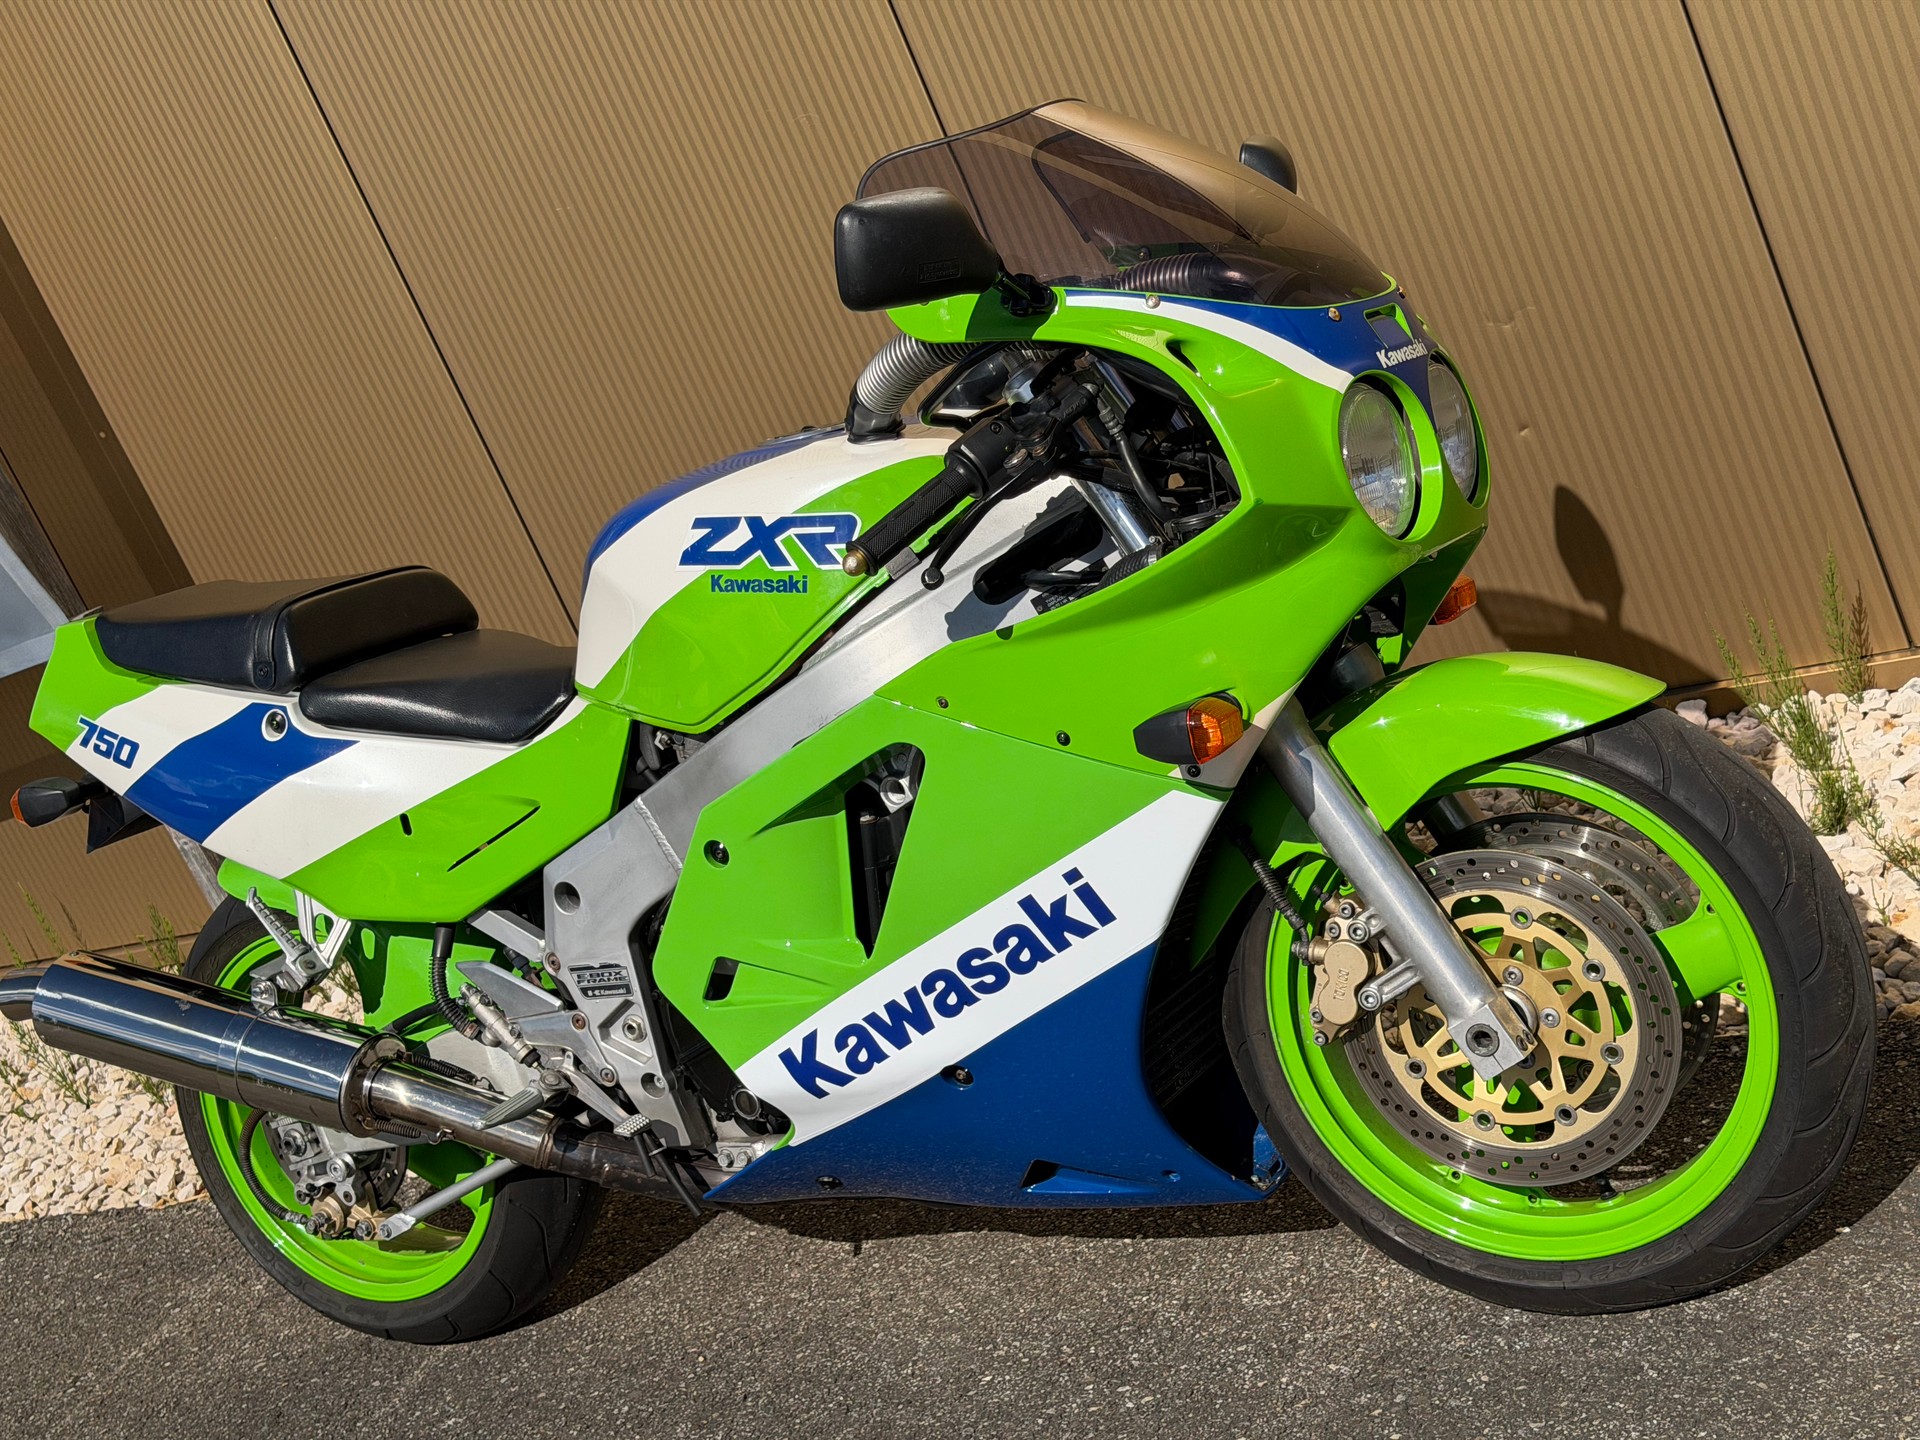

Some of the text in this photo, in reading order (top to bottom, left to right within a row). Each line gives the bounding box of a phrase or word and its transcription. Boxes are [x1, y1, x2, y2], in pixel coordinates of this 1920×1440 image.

[1376, 337, 1428, 369] Kawasaki
[678, 513, 858, 568] ZXR
[711, 574, 808, 594] Kawasaki
[79, 716, 140, 769] 750
[576, 976, 629, 985] FRAME
[778, 866, 1118, 1099] Kawasaki
